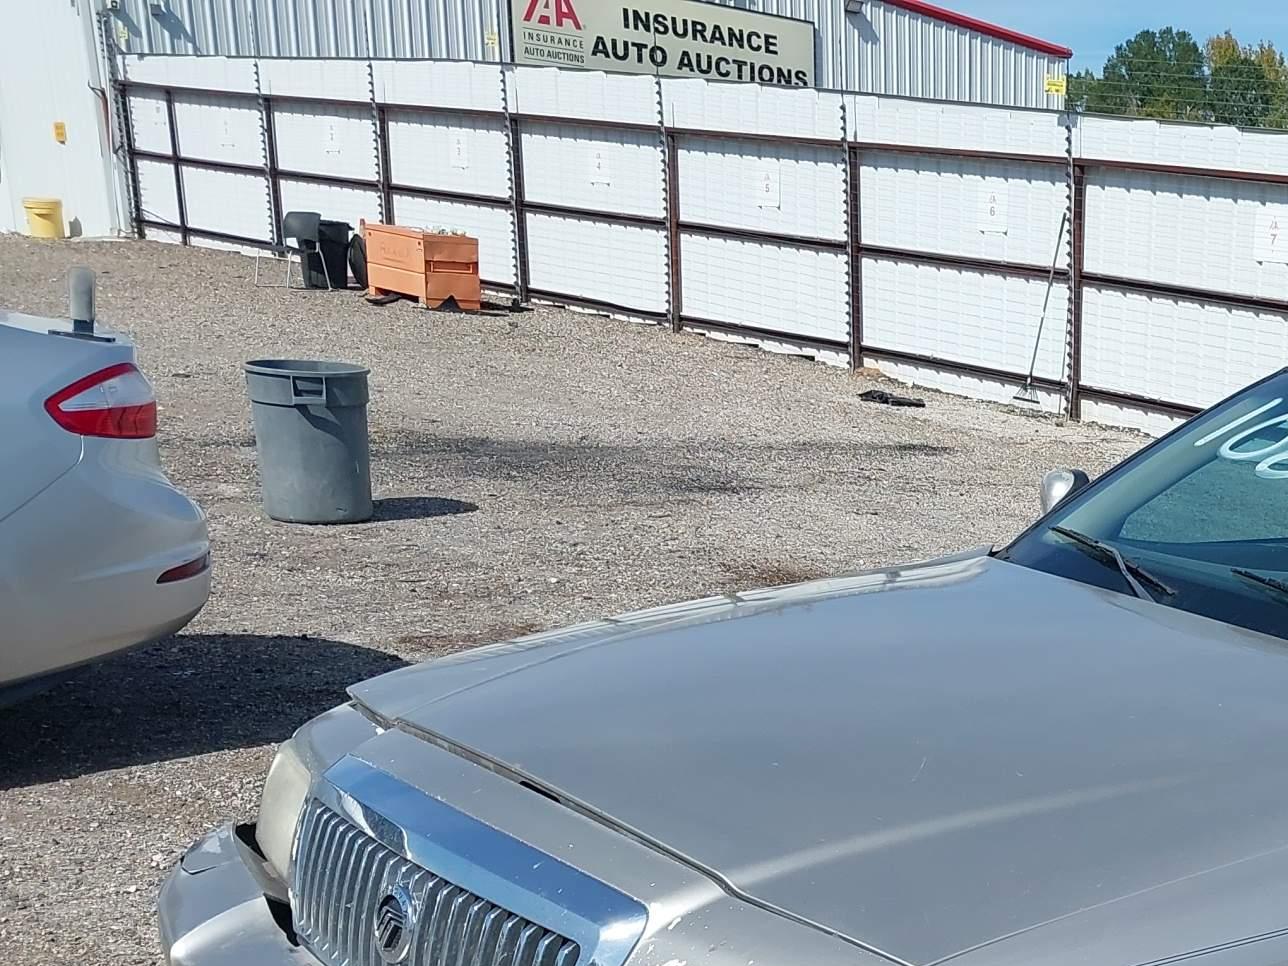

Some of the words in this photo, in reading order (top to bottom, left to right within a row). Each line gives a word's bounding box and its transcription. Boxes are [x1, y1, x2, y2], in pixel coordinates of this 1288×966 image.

[523, 31, 585, 50] INSURANCE
[622, 7, 779, 56] INSURANCE
[524, 46, 545, 58] AUTO
[546, 49, 585, 64] AUCTIONS
[591, 35, 668, 68] AUTO
[676, 50, 809, 87] AUCTIONS
[989, 206, 996, 217] 6
[1270, 233, 1278, 245] 7
